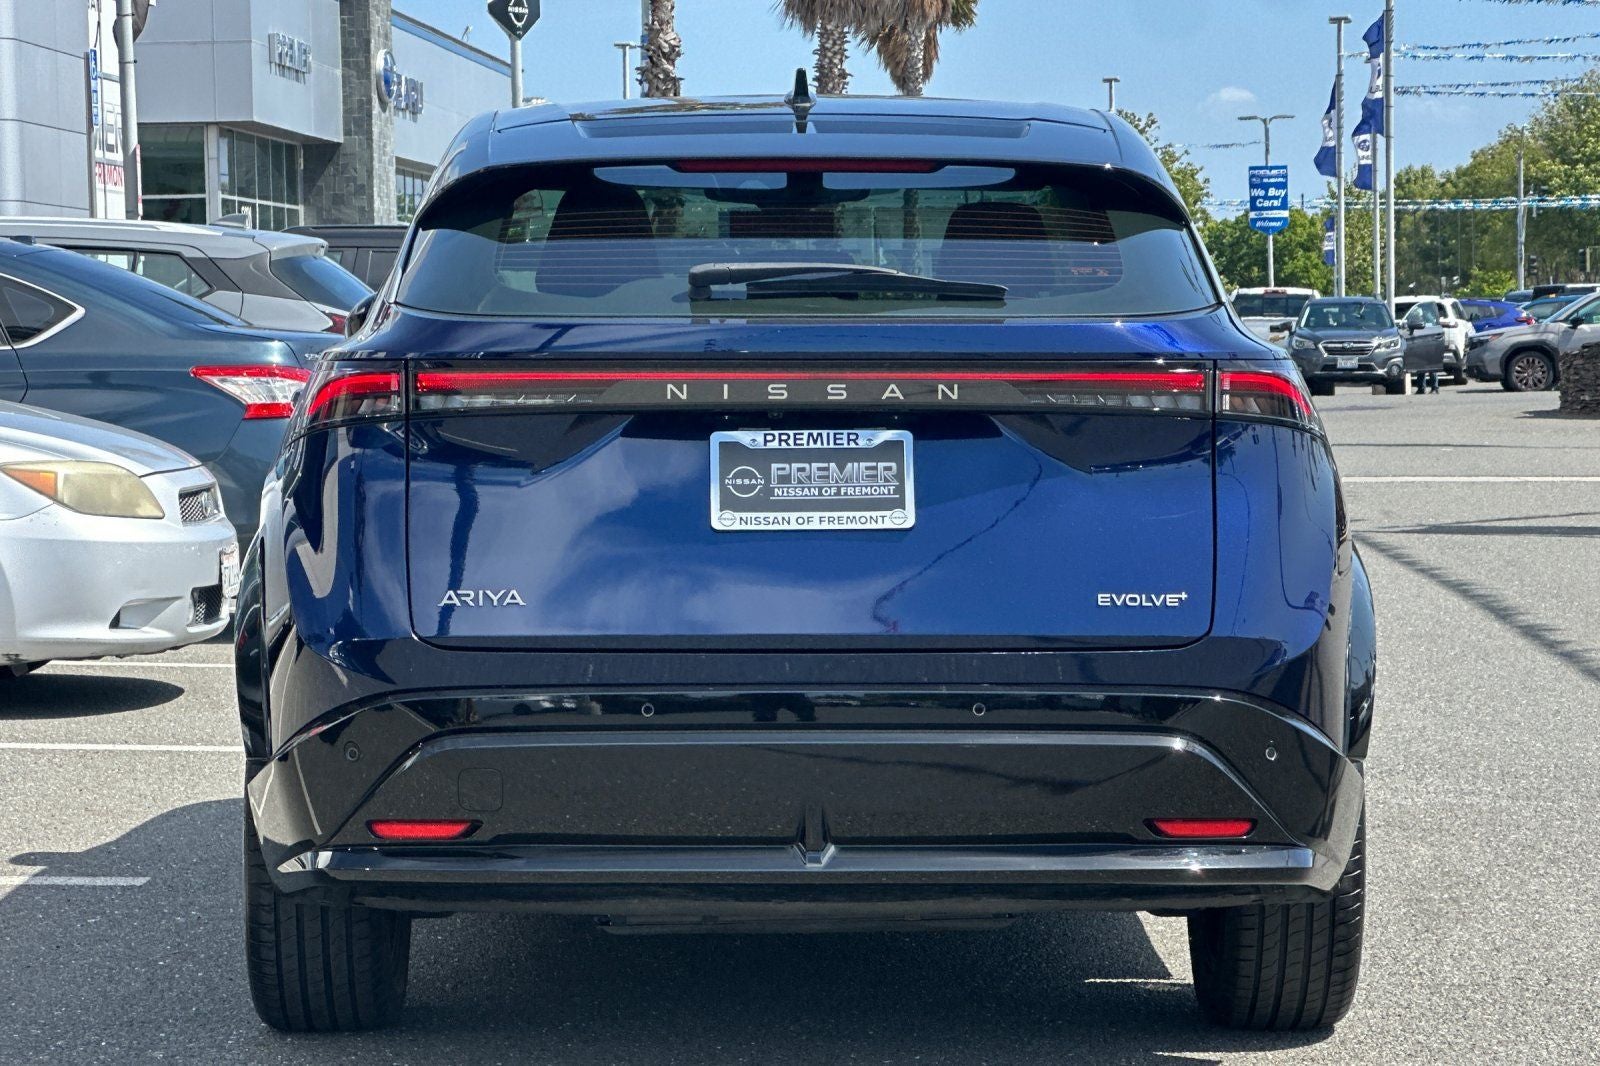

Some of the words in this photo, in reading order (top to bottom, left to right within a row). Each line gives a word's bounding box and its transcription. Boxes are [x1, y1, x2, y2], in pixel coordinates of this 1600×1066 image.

[1268, 187, 1287, 197] Buy
[1256, 198, 1282, 206] Cars!
[666, 383, 959, 400] NISSAN
[763, 432, 860, 447] PREMIER
[770, 461, 899, 484] PREMIER
[724, 478, 765, 486] NISSAN
[774, 487, 819, 497] NISSAN
[821, 487, 838, 496] OF
[841, 486, 896, 496] FREMONT
[739, 516, 791, 526] NISSAN
[795, 516, 814, 526] OF
[818, 515, 888, 526] FREMONT
[438, 589, 527, 607] ARIYA
[1097, 591, 1188, 607] EVOLVE+
